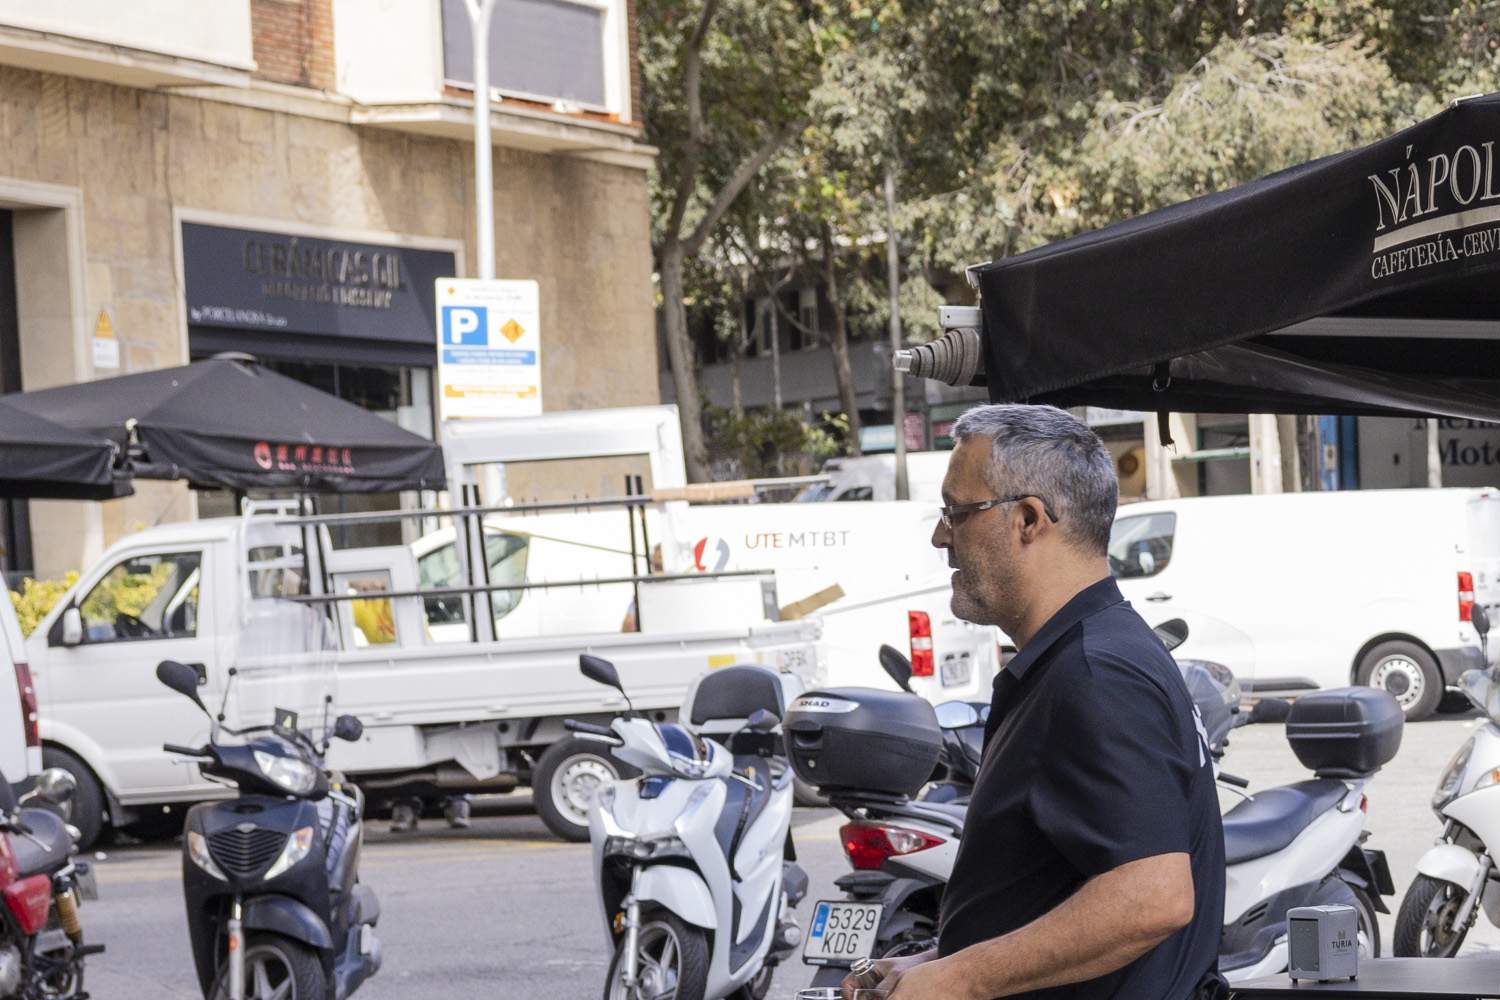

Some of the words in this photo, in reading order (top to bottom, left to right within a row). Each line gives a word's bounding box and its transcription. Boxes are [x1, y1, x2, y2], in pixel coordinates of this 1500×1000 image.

[450, 308, 479, 344] P
[744, 532, 784, 550] UTE
[788, 529, 851, 548] MTBT
[828, 907, 877, 931] 5329
[821, 931, 859, 954] KDG
[1331, 939, 1353, 949] TURIA
